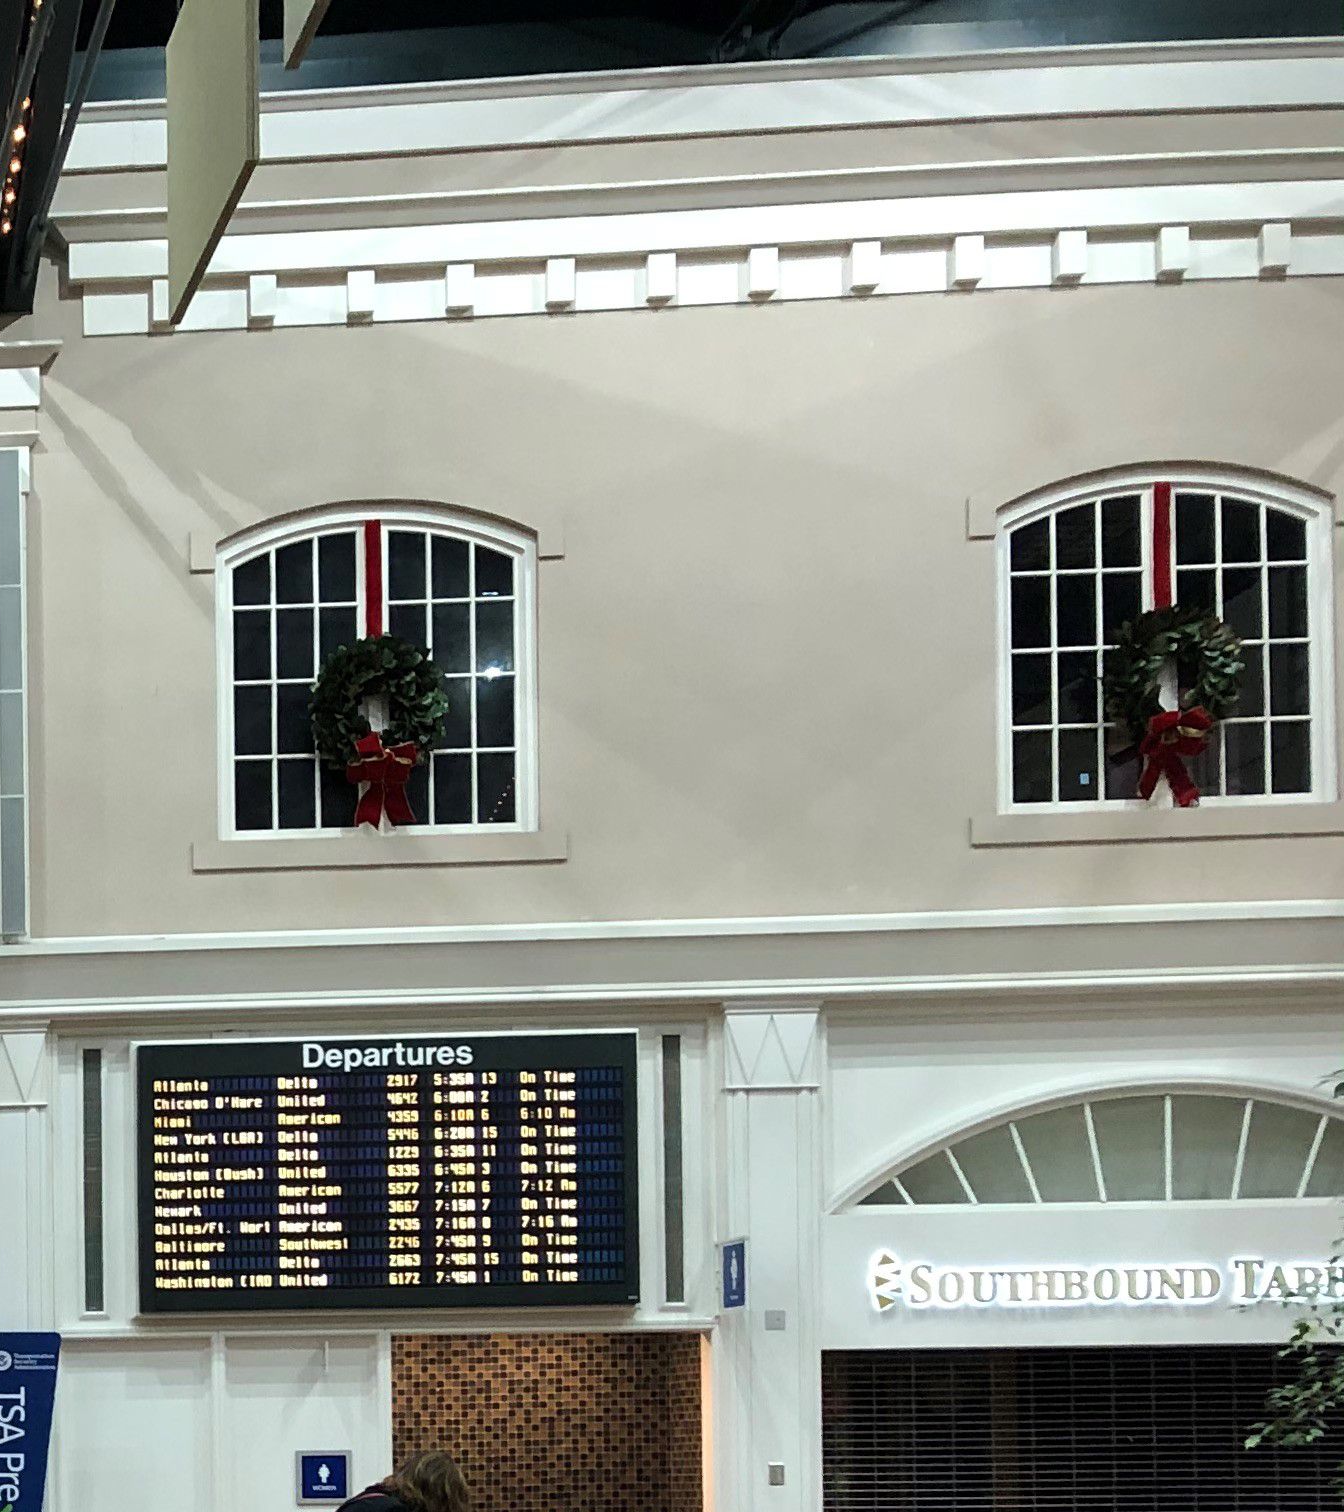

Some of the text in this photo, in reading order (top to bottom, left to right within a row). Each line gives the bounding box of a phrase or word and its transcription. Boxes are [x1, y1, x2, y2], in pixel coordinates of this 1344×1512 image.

[303, 1043, 473, 1072] Departures
[154, 1080, 208, 1092] Atlanta
[278, 1077, 318, 1089] Delta
[520, 1072, 536, 1083] On
[154, 1099, 208, 1110] Chicago
[278, 1095, 325, 1107] United
[520, 1090, 536, 1101] On
[278, 1131, 318, 1143] Delta
[521, 1126, 536, 1137] On
[155, 1151, 208, 1163] Atlanta
[278, 1149, 318, 1161] Delta
[521, 1144, 537, 1156] On
[278, 1166, 326, 1179] United
[521, 1162, 537, 1174] On
[155, 1187, 224, 1199] Charlotte
[279, 1202, 326, 1215] United
[521, 1198, 537, 1210] On
[279, 1238, 347, 1250] Southwest
[522, 1234, 538, 1246] On
[156, 1258, 210, 1270] Atlanta
[279, 1256, 319, 1268] Delta
[522, 1252, 538, 1264] On
[280, 1274, 327, 1286] United
[523, 1270, 538, 1282] On
[911, 1265, 1221, 1303] SOUTHBOUND
